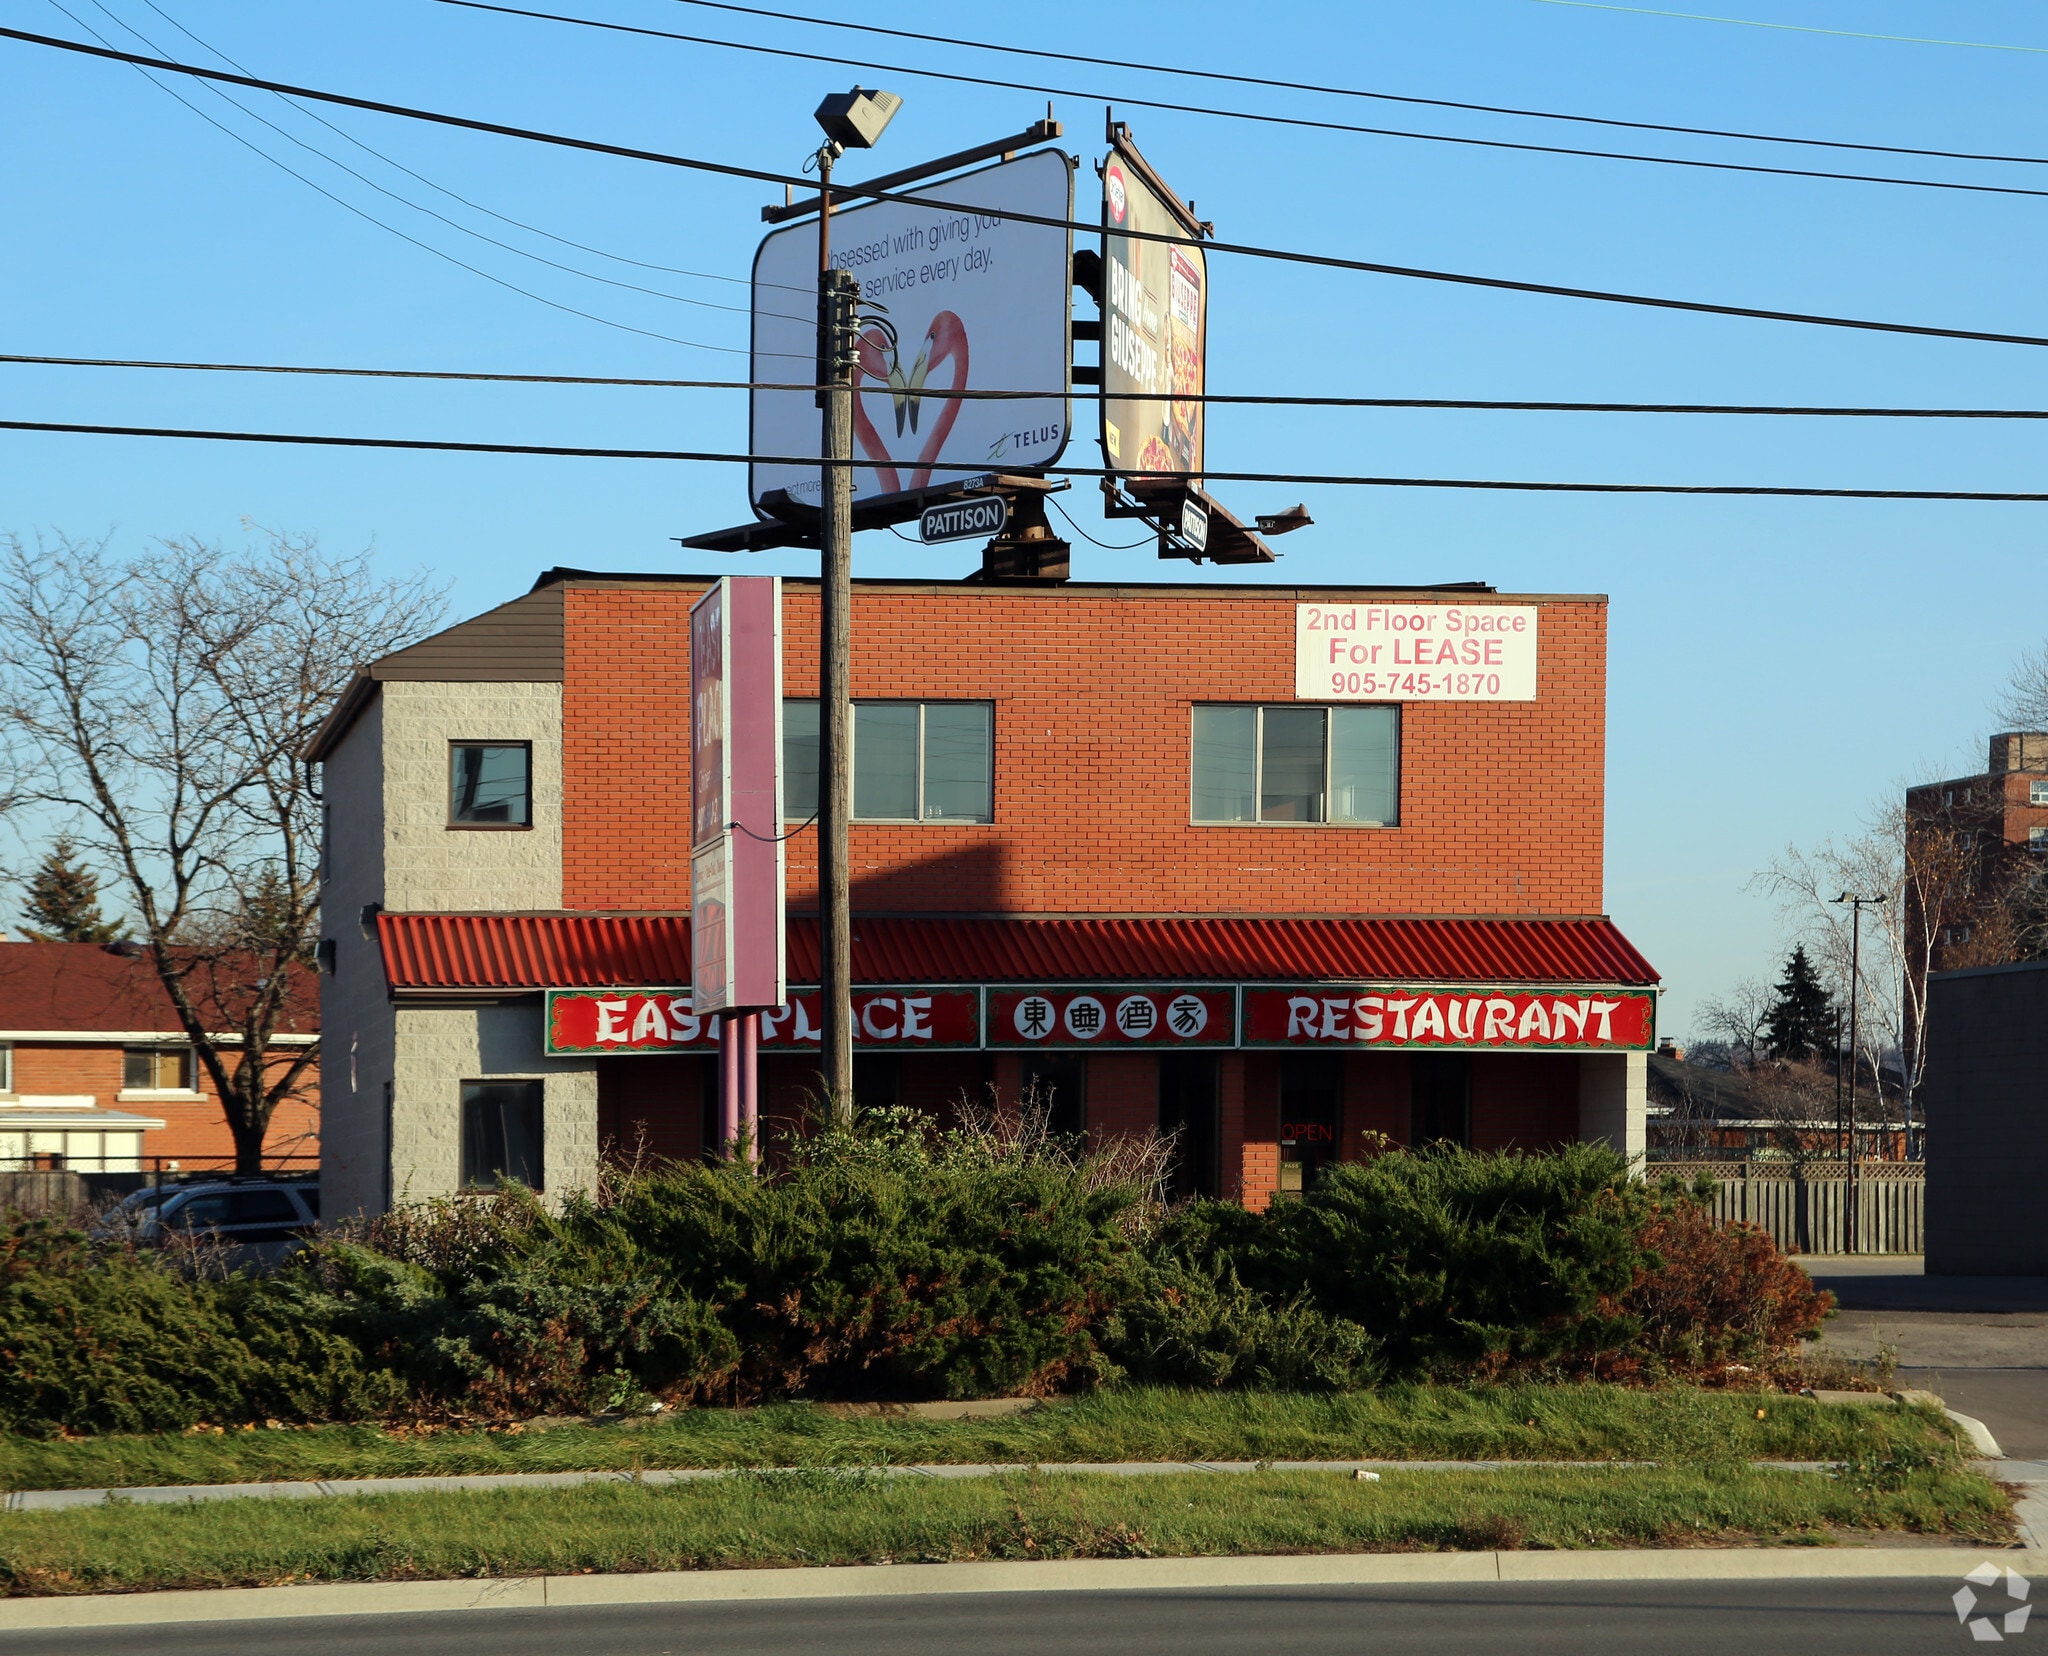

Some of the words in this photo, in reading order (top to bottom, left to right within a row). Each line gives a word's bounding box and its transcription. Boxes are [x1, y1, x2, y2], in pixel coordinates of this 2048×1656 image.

[893, 225, 924, 255] with
[928, 215, 969, 251] giving
[974, 207, 1002, 239] you
[865, 267, 916, 299] service
[920, 256, 960, 281] every
[963, 246, 993, 273] day.
[1111, 256, 1142, 328] BRING
[1111, 313, 1158, 395] GIUSEPPE
[1014, 424, 1059, 449] TELUS
[963, 477, 983, 490] 8273A
[926, 504, 999, 536] PATTISON
[1184, 507, 1206, 544] PATTISON
[1306, 608, 1357, 632] 2nd
[1367, 608, 1438, 632] Floor
[1445, 608, 1527, 637] Space
[1329, 638, 1383, 664] For
[1394, 638, 1504, 666] LEASE
[1331, 672, 1501, 695] 905-745-1870
[1287, 996, 1622, 1041] RESTAURANT
[1281, 1123, 1333, 1141] OPEN
